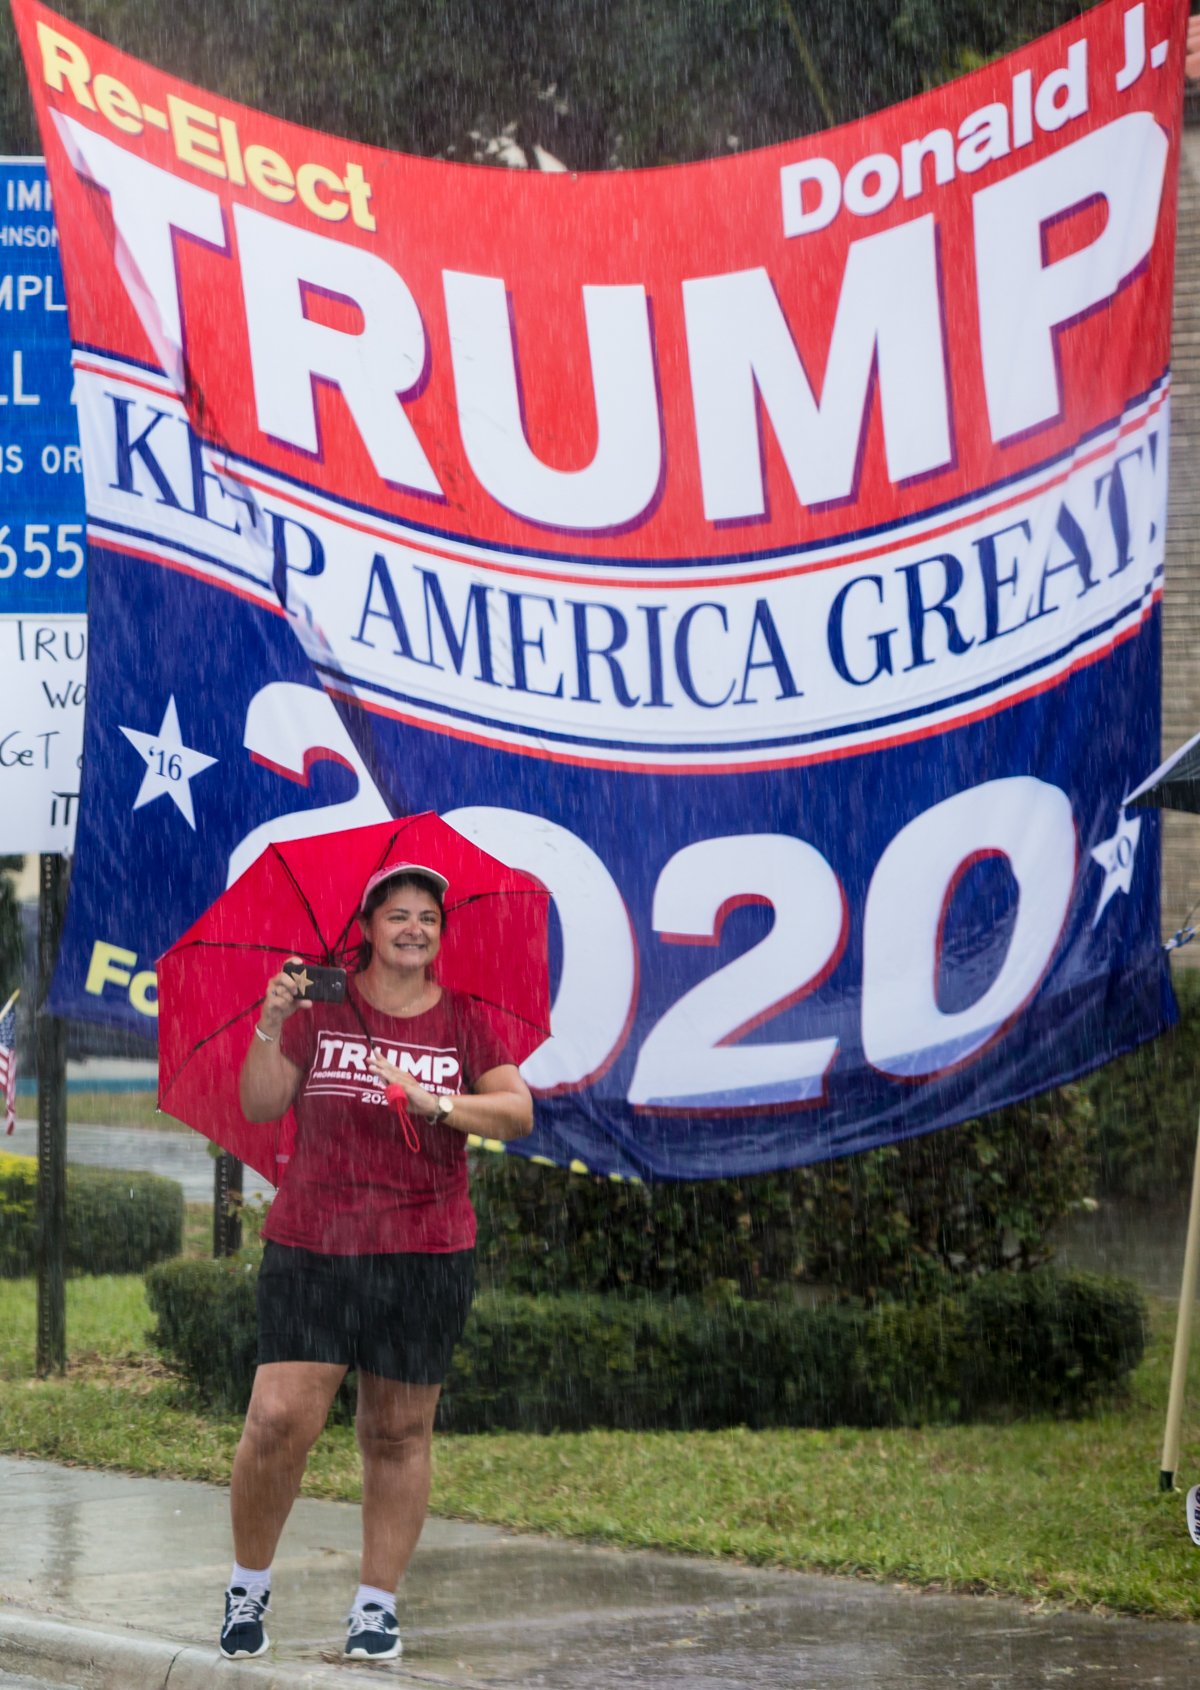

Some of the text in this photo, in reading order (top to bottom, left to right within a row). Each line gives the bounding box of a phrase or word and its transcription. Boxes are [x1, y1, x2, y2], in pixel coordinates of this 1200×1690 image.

[37, 20, 377, 232] Re-Elect
[780, 2, 1169, 238] Donald J.
[47, 106, 1170, 532] TRUMP
[41, 446, 82, 474] OR
[350, 551, 804, 709] AMERICA
[320, 1039, 460, 1084] TRUMP
[362, 1092, 389, 1106] 202
